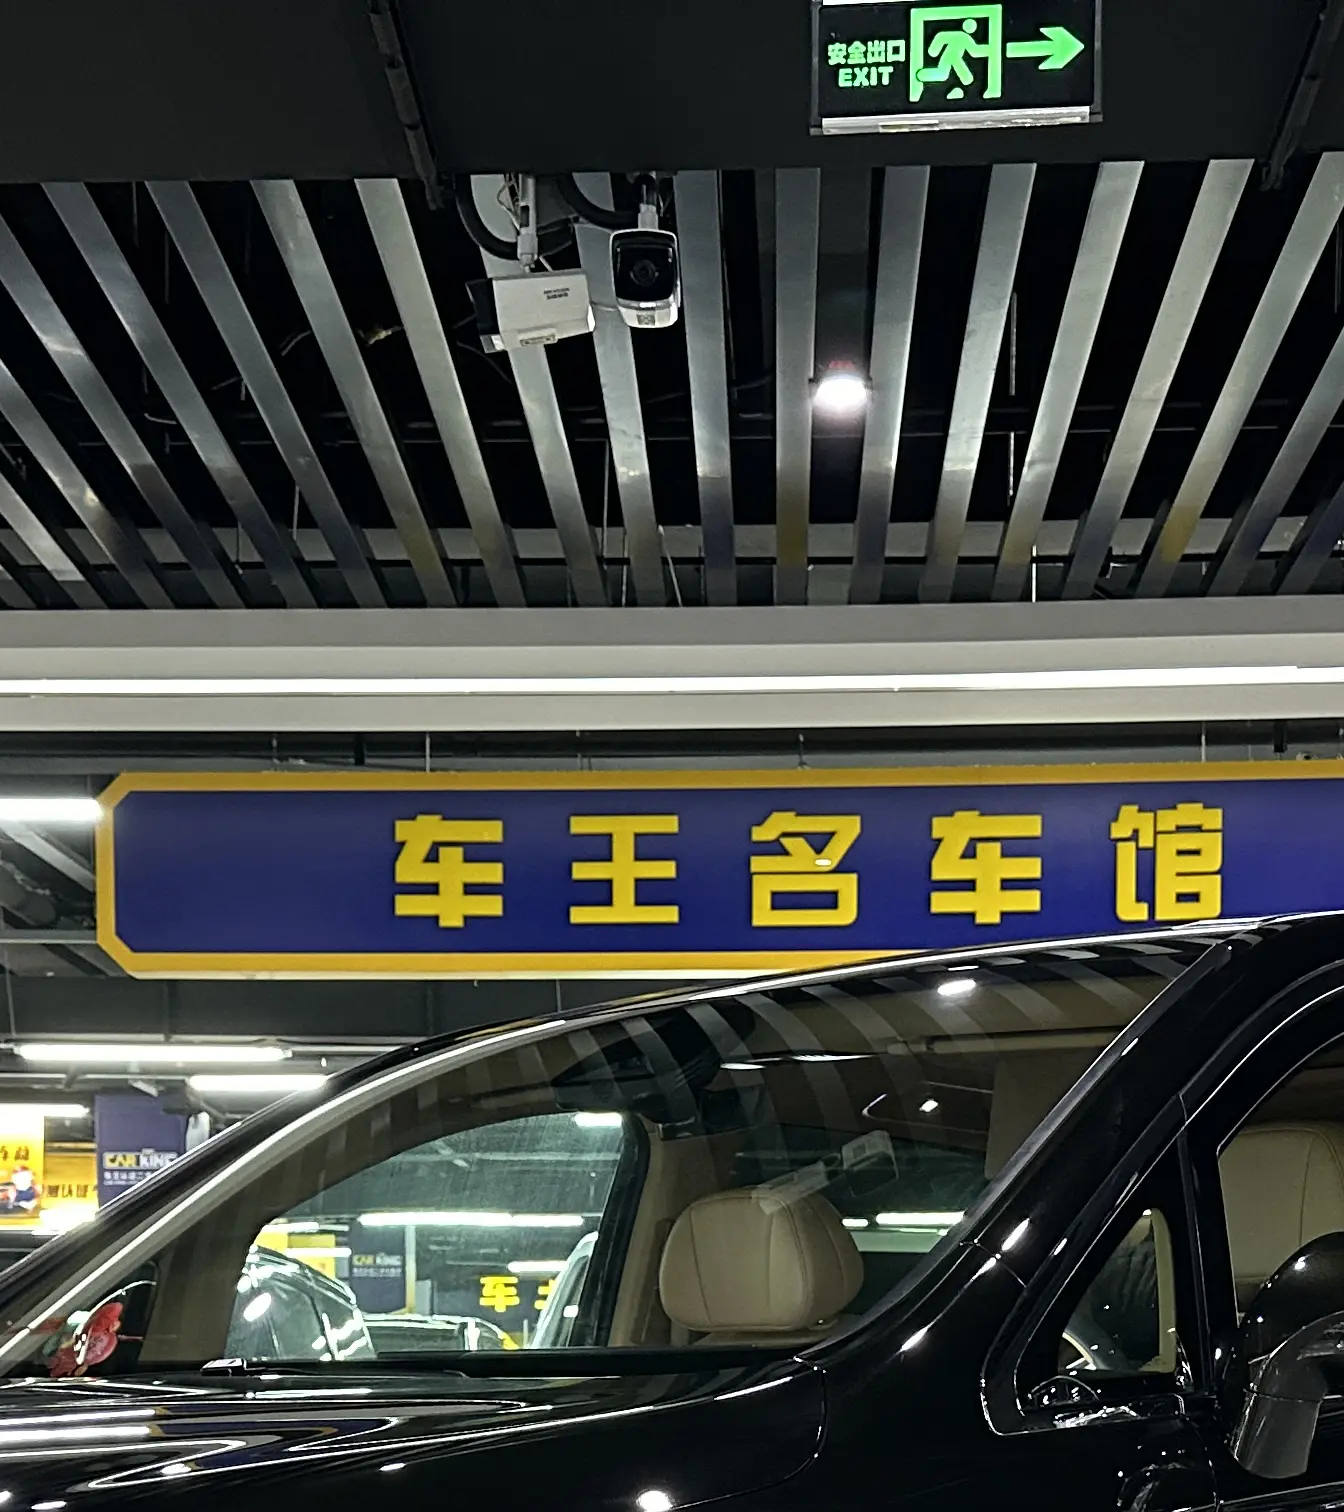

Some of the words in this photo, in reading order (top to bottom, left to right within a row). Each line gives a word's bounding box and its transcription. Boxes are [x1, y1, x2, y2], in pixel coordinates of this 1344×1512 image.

[827, 39, 905, 65] 安全出口
[838, 67, 894, 87] EXIT
[394, 802, 1224, 927] 车王名车馆
